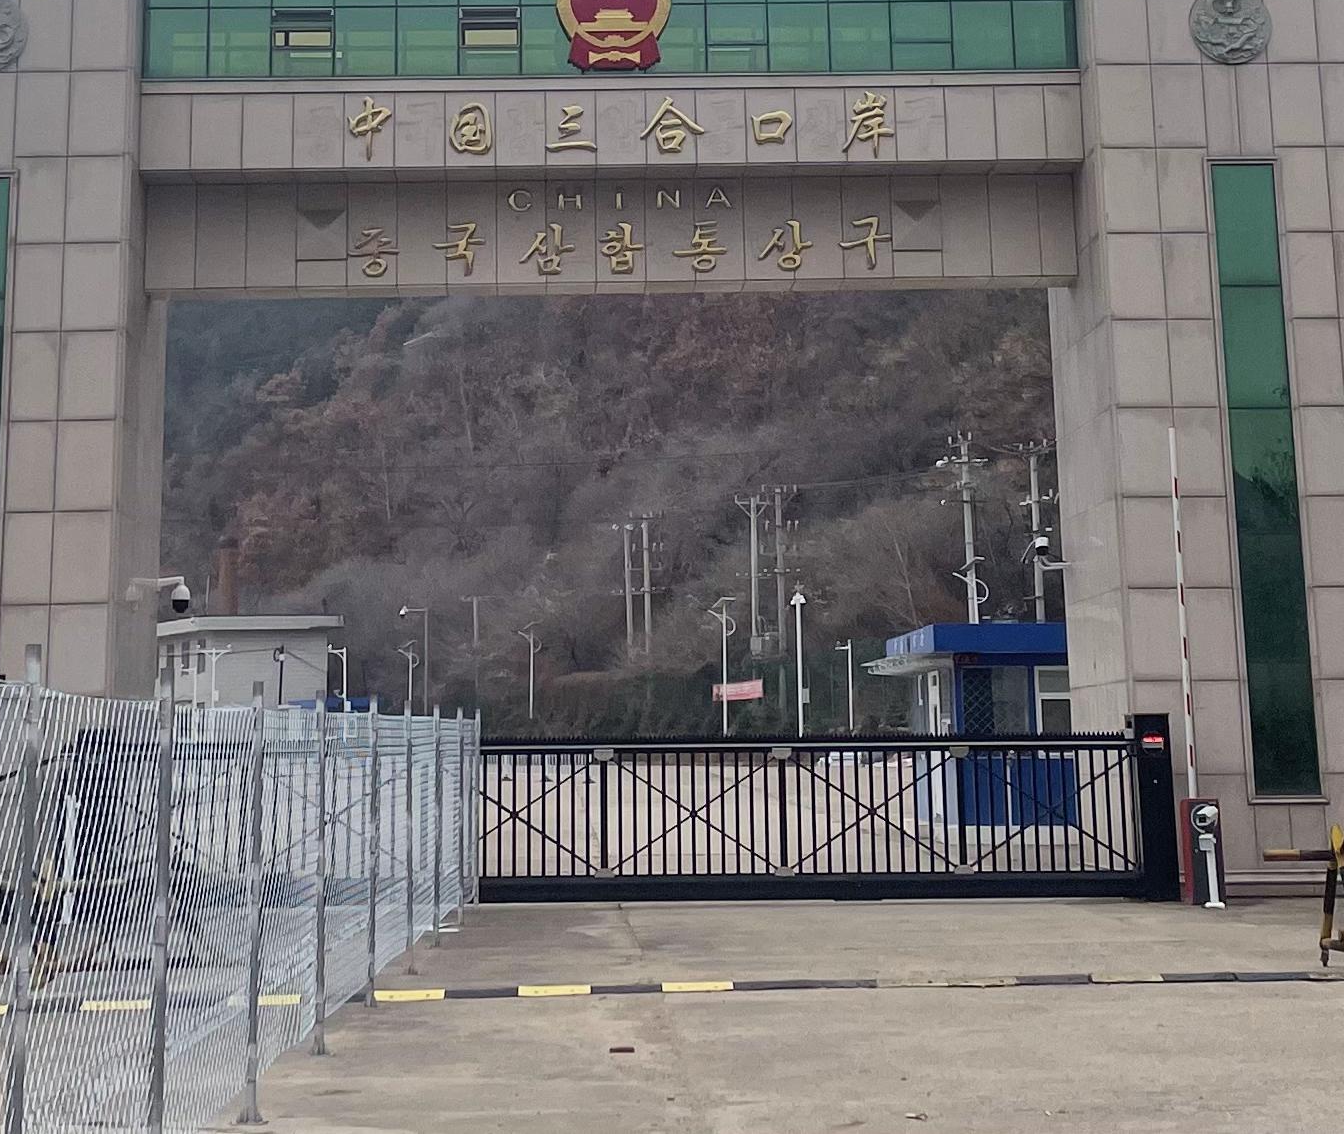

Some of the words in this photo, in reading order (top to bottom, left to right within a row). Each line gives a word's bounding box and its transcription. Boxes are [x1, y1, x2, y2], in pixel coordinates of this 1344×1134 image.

[347, 91, 895, 162] 中国三合口岸
[508, 187, 732, 211] CHINA
